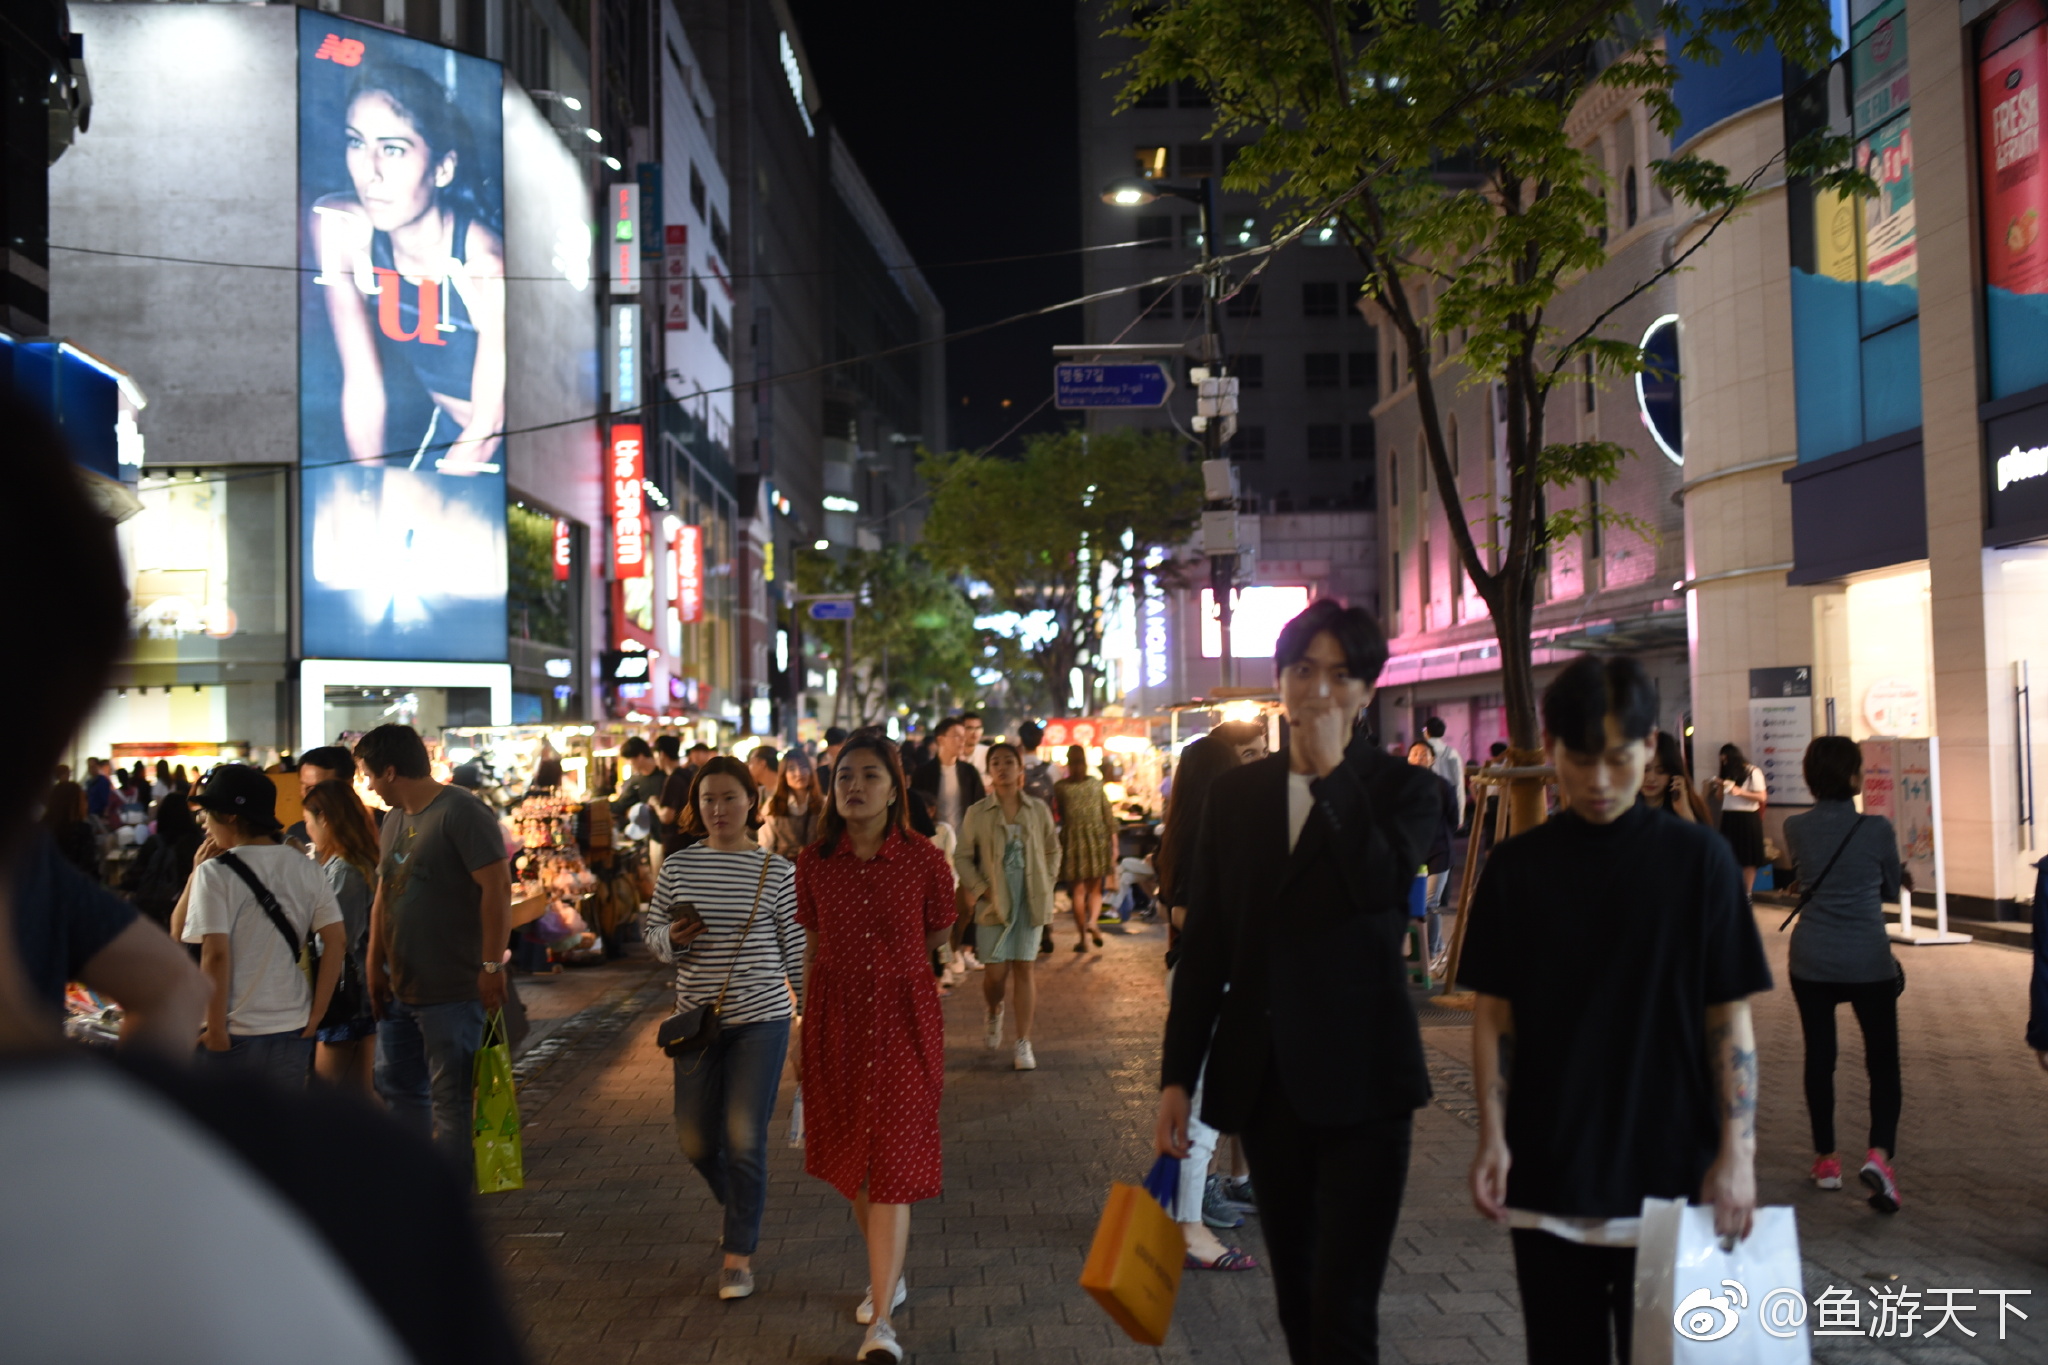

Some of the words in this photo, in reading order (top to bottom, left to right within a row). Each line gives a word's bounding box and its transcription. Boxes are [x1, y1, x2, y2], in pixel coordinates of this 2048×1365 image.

[1993, 83, 2040, 148] FRESH
[614, 440, 640, 478] the
[615, 479, 642, 565] SAEM
